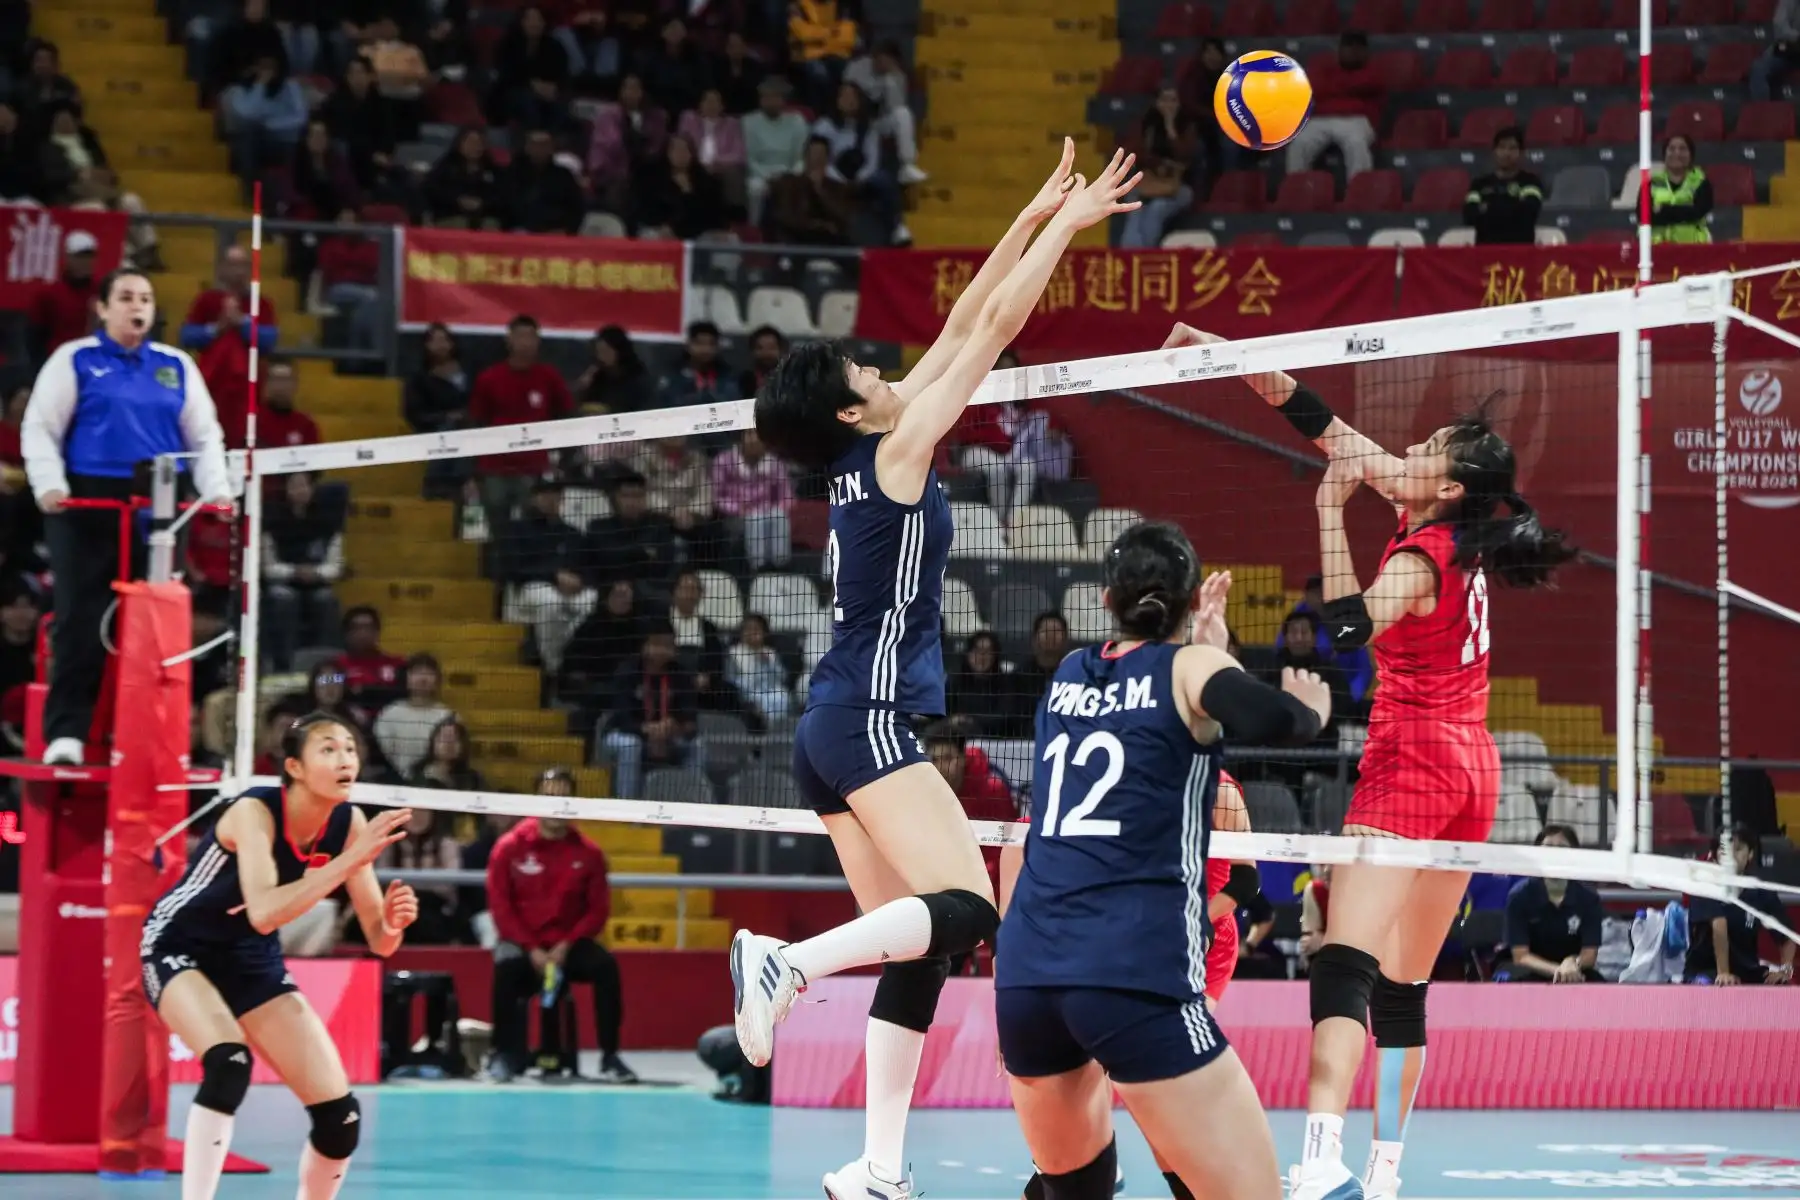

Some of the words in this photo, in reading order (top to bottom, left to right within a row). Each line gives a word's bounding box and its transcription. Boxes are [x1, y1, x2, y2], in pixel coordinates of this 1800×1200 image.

[932, 250, 1282, 316] 秘福建同乡会
[1737, 430, 1772, 449] U17
[1099, 675, 1158, 717] S.M.
[1040, 730, 1125, 837] 12
